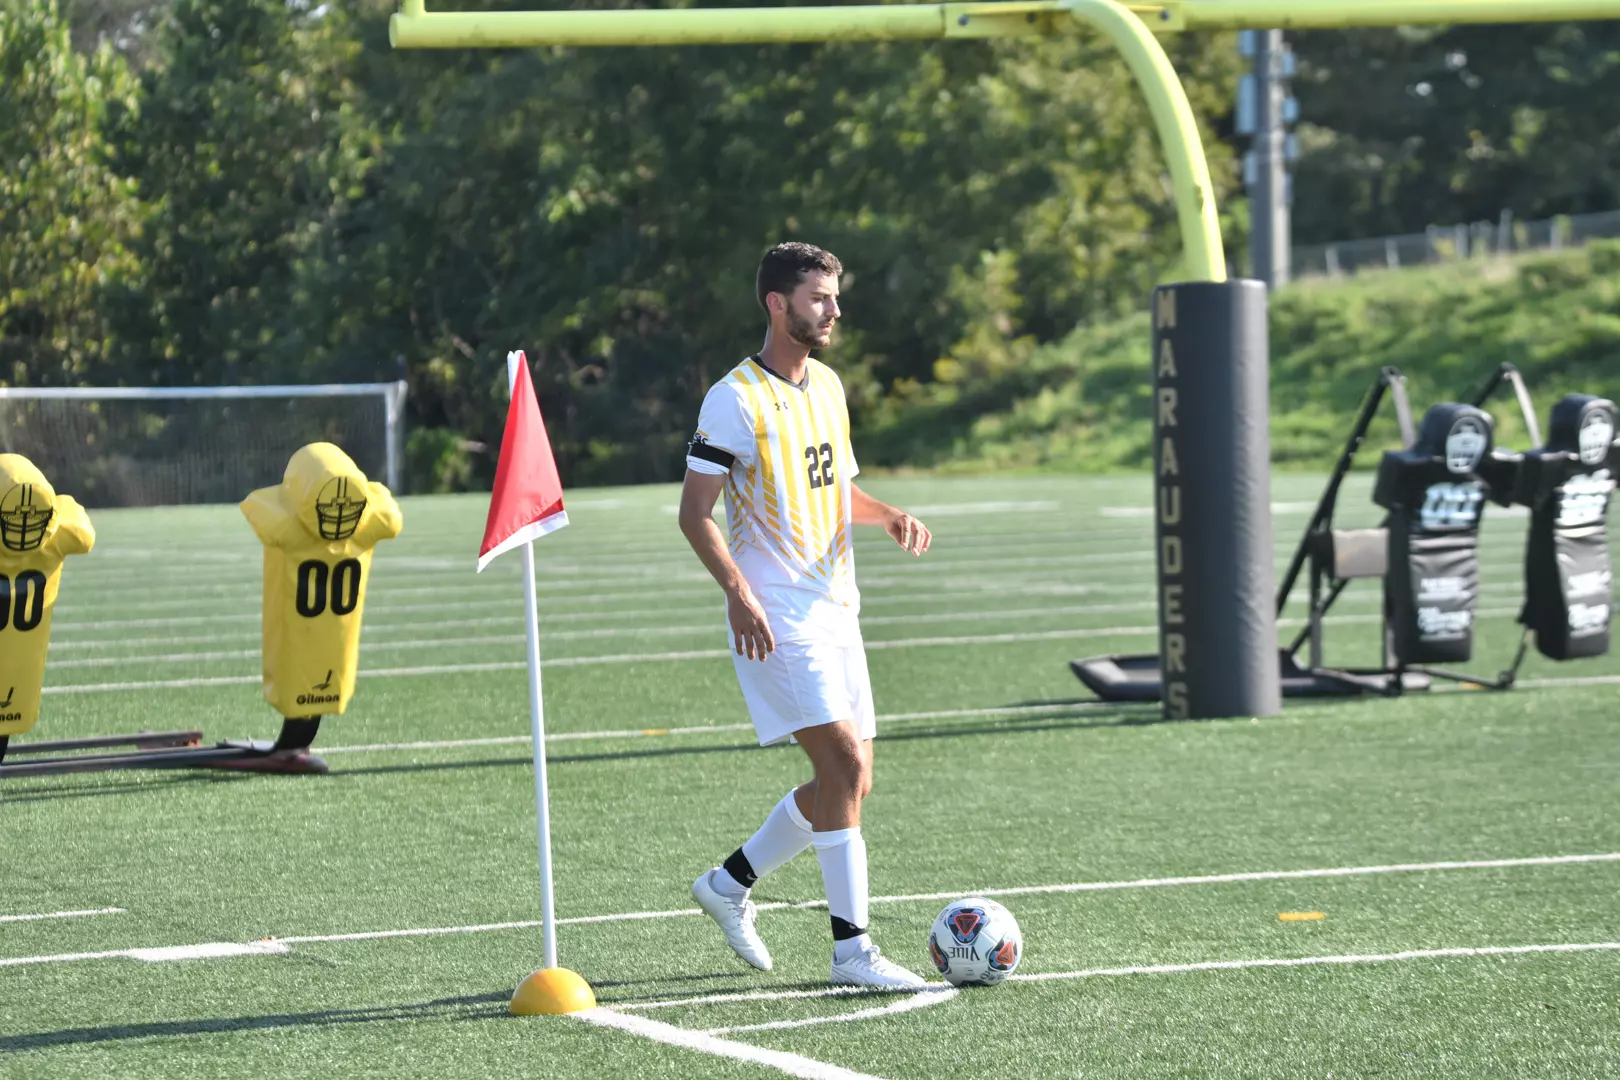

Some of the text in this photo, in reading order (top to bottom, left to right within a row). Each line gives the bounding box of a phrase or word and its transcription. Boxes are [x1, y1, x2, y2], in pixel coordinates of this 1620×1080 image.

[805, 442, 834, 489] 22
[1157, 289, 1189, 720] MARAUDERS
[296, 558, 362, 618] 00
[296, 692, 340, 705] Gilman
